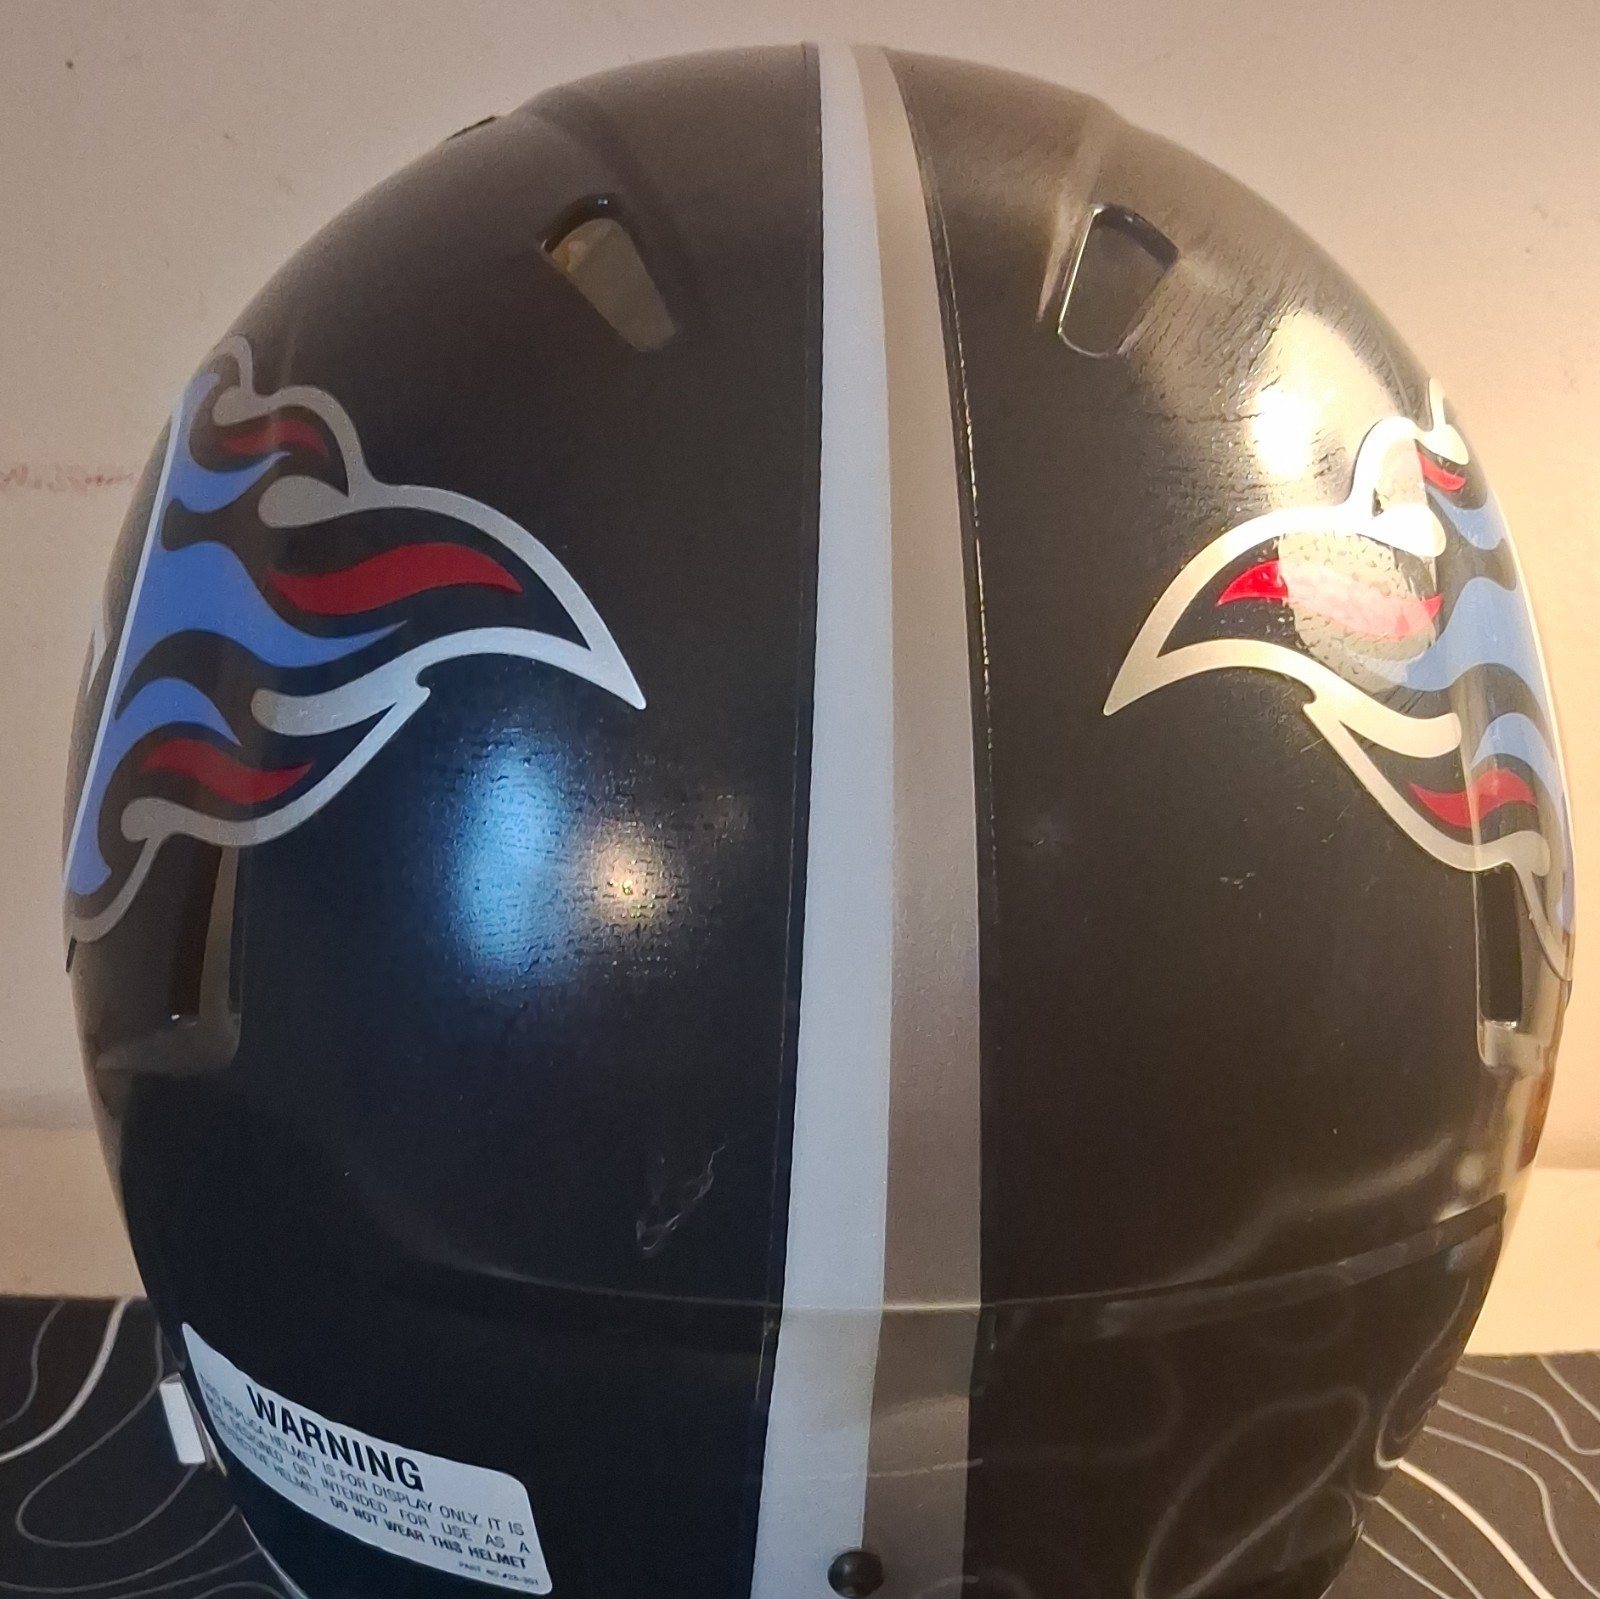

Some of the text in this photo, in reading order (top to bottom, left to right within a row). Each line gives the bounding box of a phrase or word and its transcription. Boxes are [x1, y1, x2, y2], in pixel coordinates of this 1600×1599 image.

[246, 1383, 425, 1493] WARNING
[268, 1432, 317, 1469] HELMET
[322, 1461, 336, 1477] IS
[340, 1468, 368, 1492] FOR
[372, 1482, 433, 1514] DISPLAY
[488, 1517, 502, 1531] IT
[508, 1521, 525, 1536] IS
[292, 1461, 312, 1480] OR
[321, 1475, 388, 1514] INTENDED
[400, 1508, 431, 1530] FOR
[441, 1521, 474, 1542] USE
[485, 1534, 506, 1550] AS
[519, 1541, 531, 1554] A
[330, 1495, 349, 1513] DO
[352, 1506, 379, 1527] NOT
[383, 1518, 426, 1543] WEAR
[429, 1533, 463, 1554] THIS
[468, 1545, 527, 1570] HELMET
